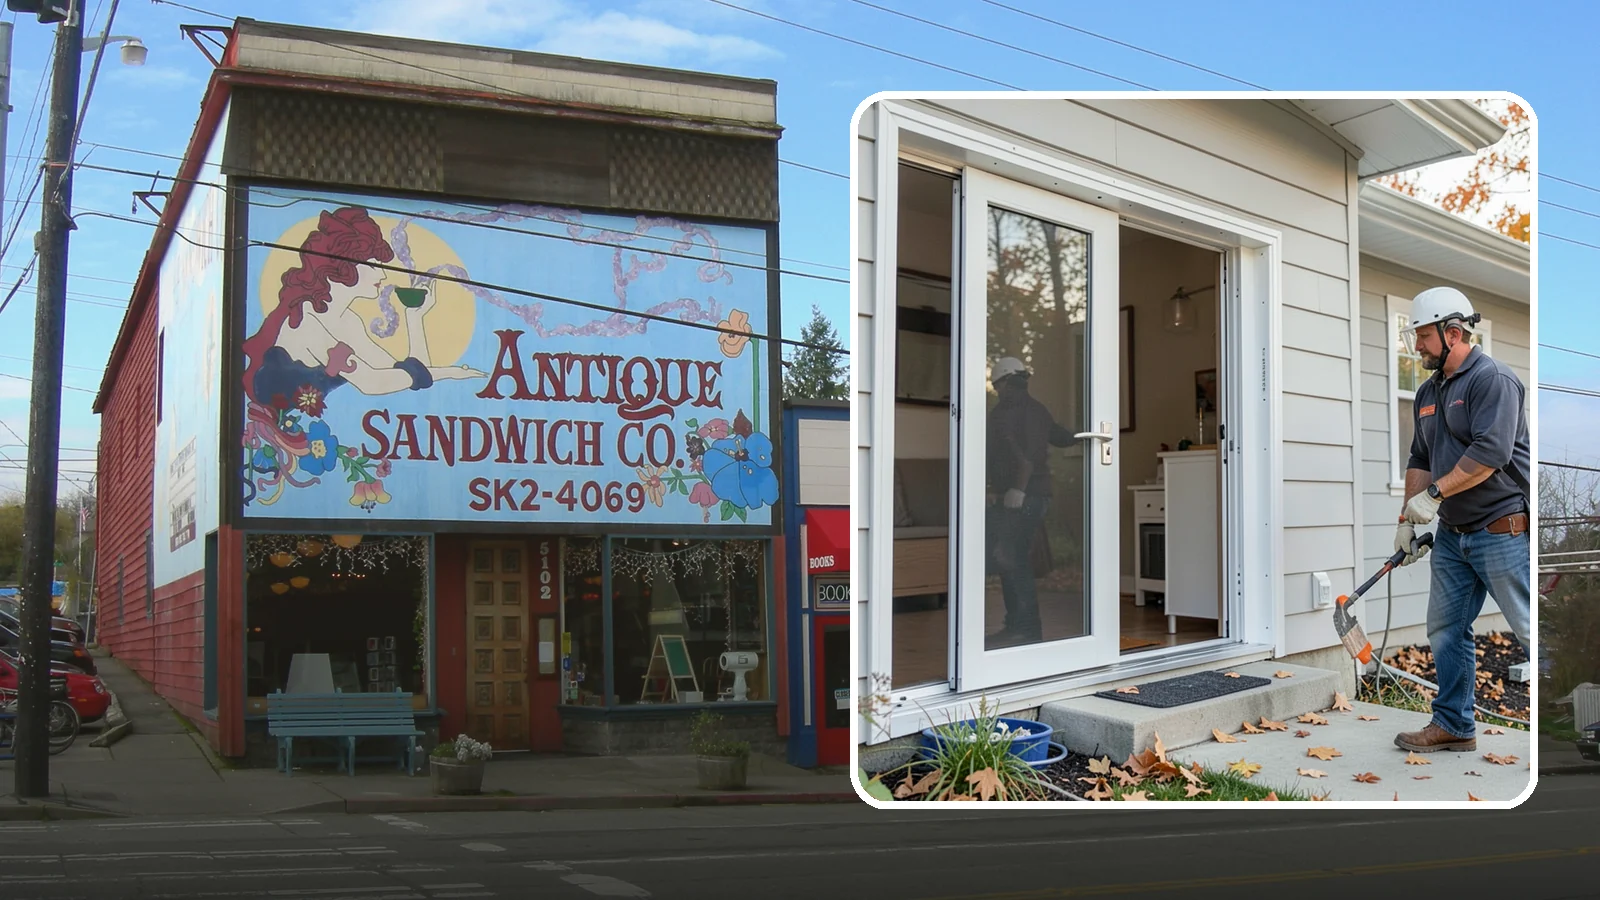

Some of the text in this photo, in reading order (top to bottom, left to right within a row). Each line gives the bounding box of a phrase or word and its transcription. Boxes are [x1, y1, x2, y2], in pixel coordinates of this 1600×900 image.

[475, 329, 723, 420] ANTIQUE
[361, 409, 685, 469] SANDWICH CO.
[468, 477, 646, 513] SK2-4069
[540, 541, 551, 600] 5102
[809, 555, 835, 569] BOOKS
